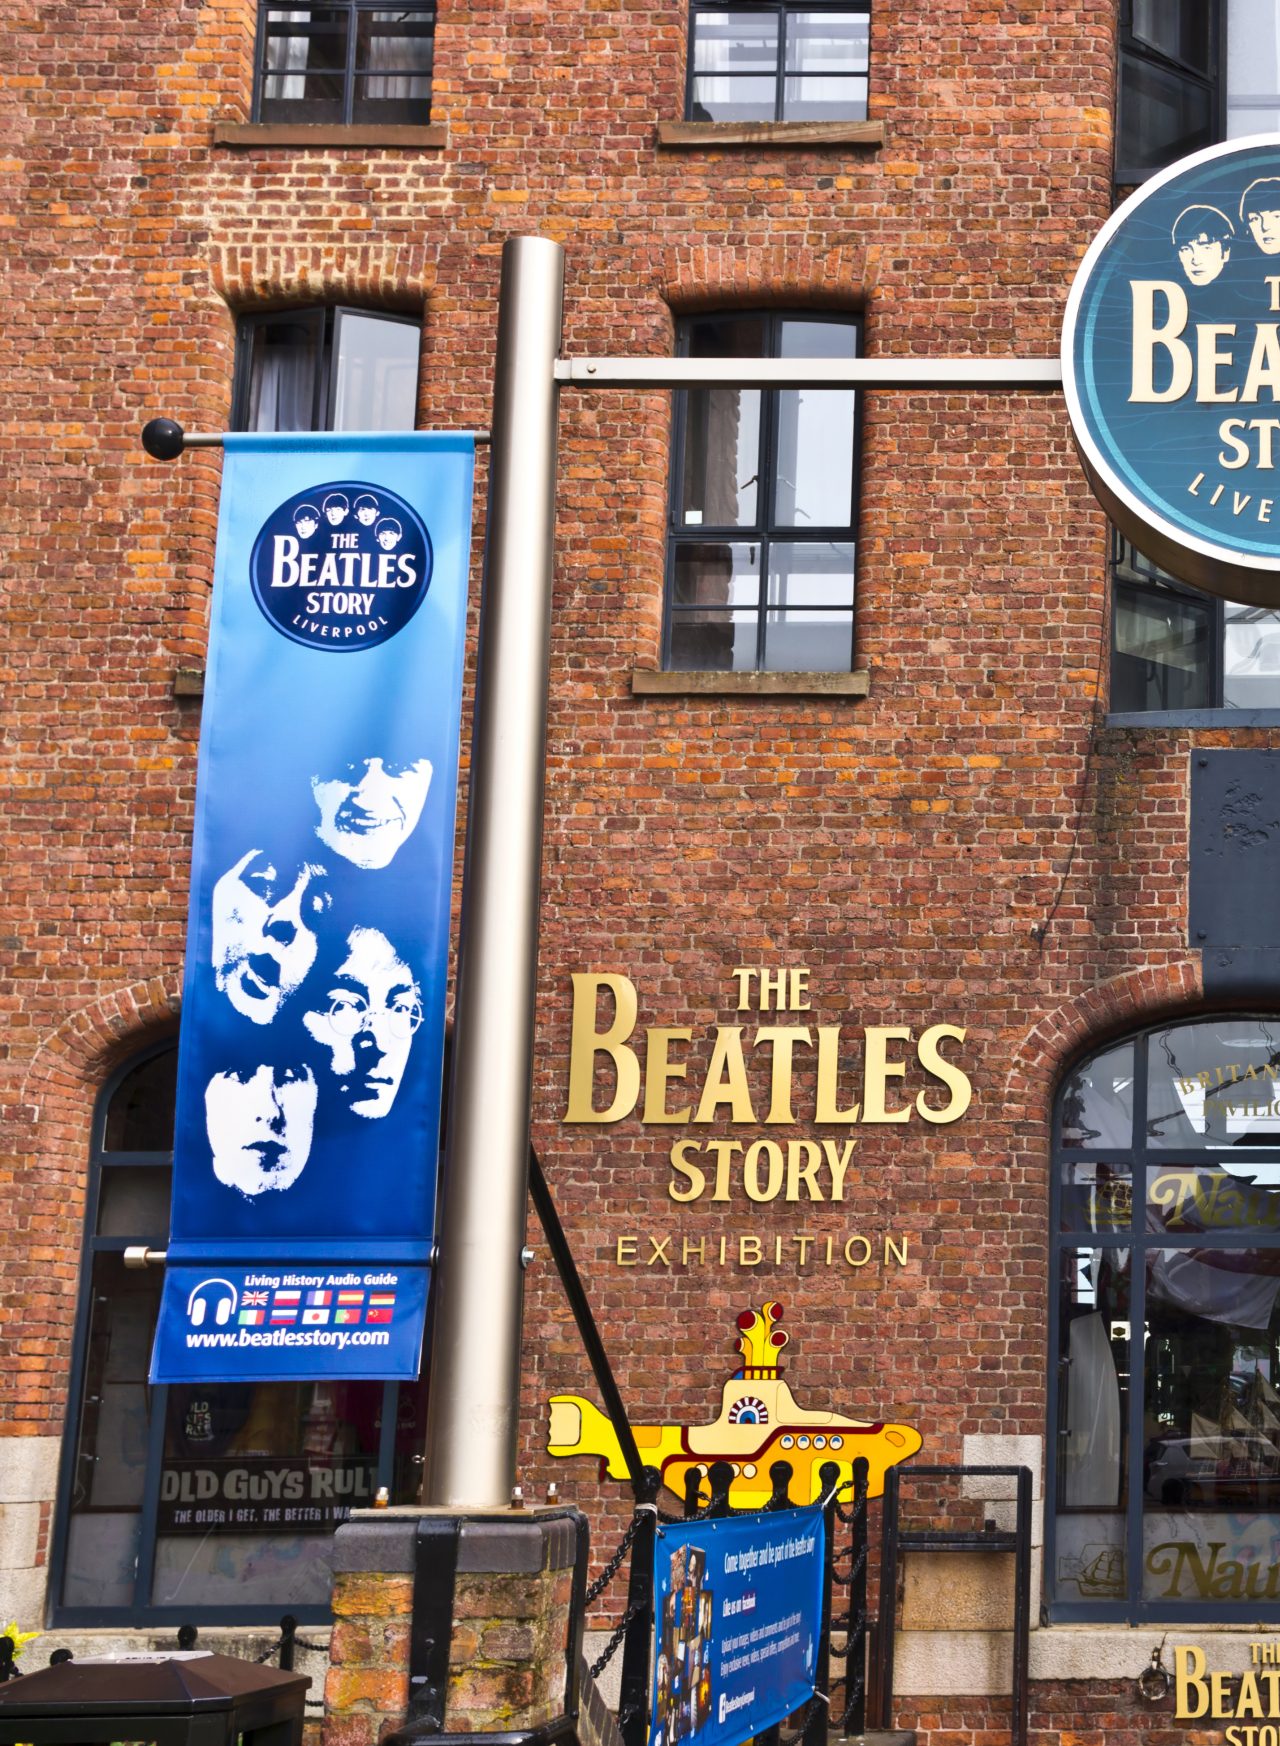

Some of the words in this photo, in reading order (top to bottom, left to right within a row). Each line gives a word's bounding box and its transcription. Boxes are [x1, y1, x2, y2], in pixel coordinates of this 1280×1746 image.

[331, 533, 359, 549] THE
[270, 535, 417, 588] BEATLES
[306, 592, 375, 615] STORY
[292, 614, 388, 637] LIVERPOOL
[732, 968, 811, 1011] THE
[562, 972, 972, 1124] BEATLES
[668, 1139, 858, 1202] STORY
[616, 1235, 909, 1267] EXHIBITION
[244, 1275, 280, 1289] Living
[282, 1275, 324, 1288] History
[327, 1274, 361, 1285] Audio
[364, 1273, 398, 1285] Guide
[186, 1328, 389, 1349] www.beatlesstory.com
[161, 1470, 219, 1502] OLD
[223, 1469, 304, 1500] GUYS
[174, 1510, 191, 1523] THE
[195, 1510, 225, 1522] OLDER
[229, 1510, 233, 1521] I
[264, 1509, 281, 1521] THE
[285, 1507, 321, 1521] BETTER
[325, 1507, 328, 1519] I
[333, 1507, 355, 1519] WA
[725, 1552, 738, 1574] Come
